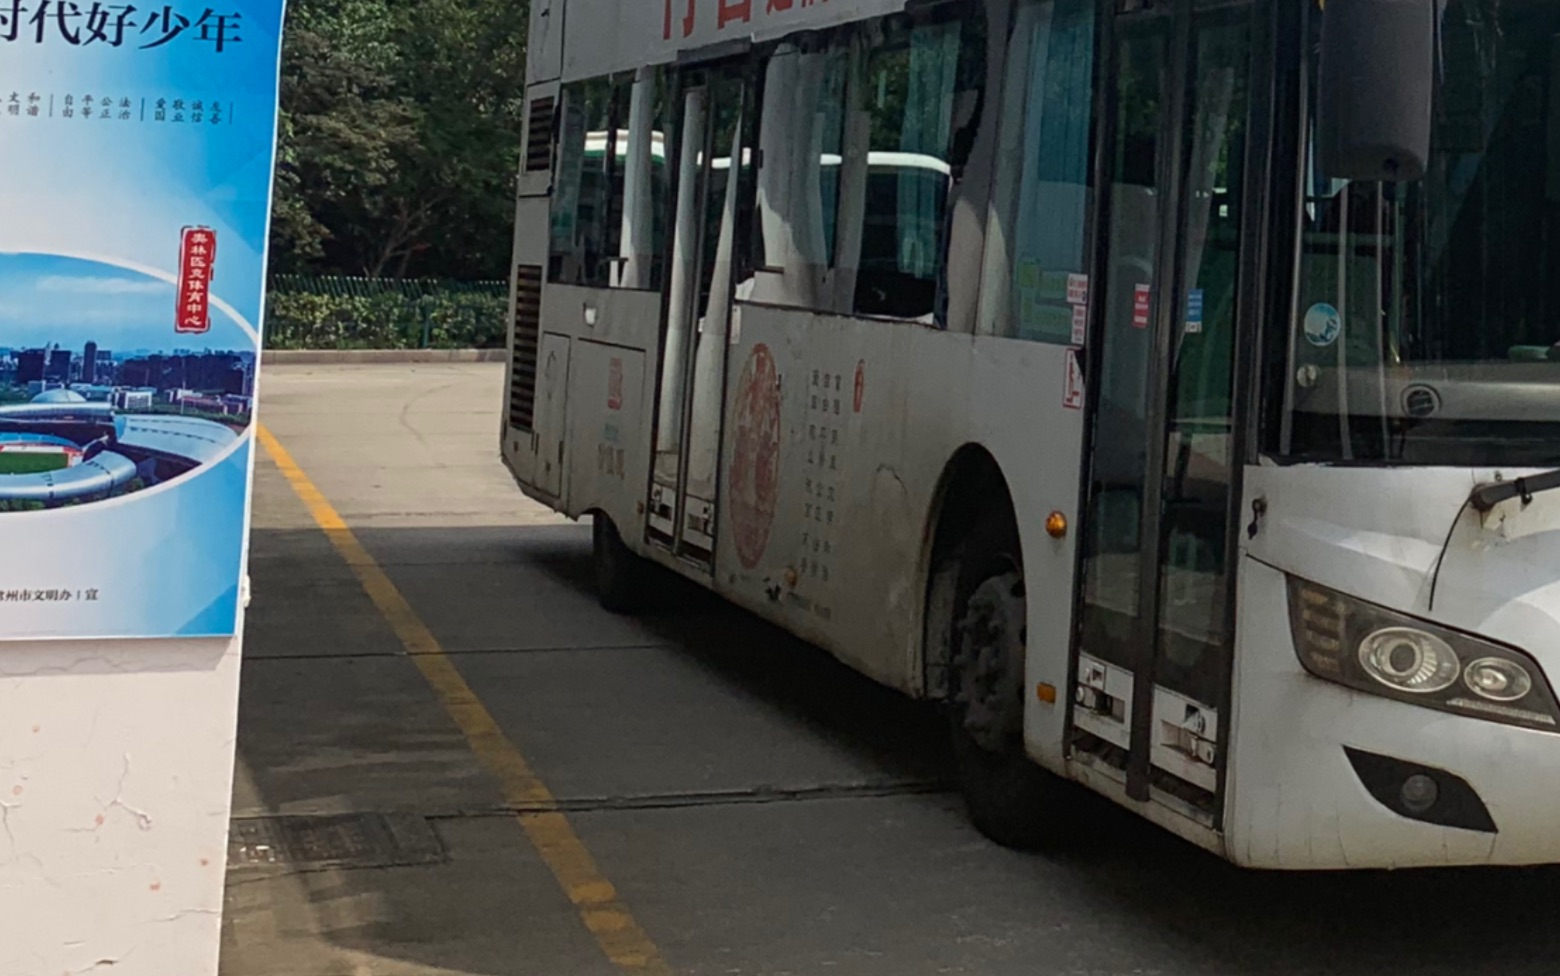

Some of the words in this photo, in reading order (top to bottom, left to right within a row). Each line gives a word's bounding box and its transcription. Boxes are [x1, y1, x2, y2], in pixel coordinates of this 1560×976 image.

[184, 232, 208, 326] 奥林匹克体育中心
